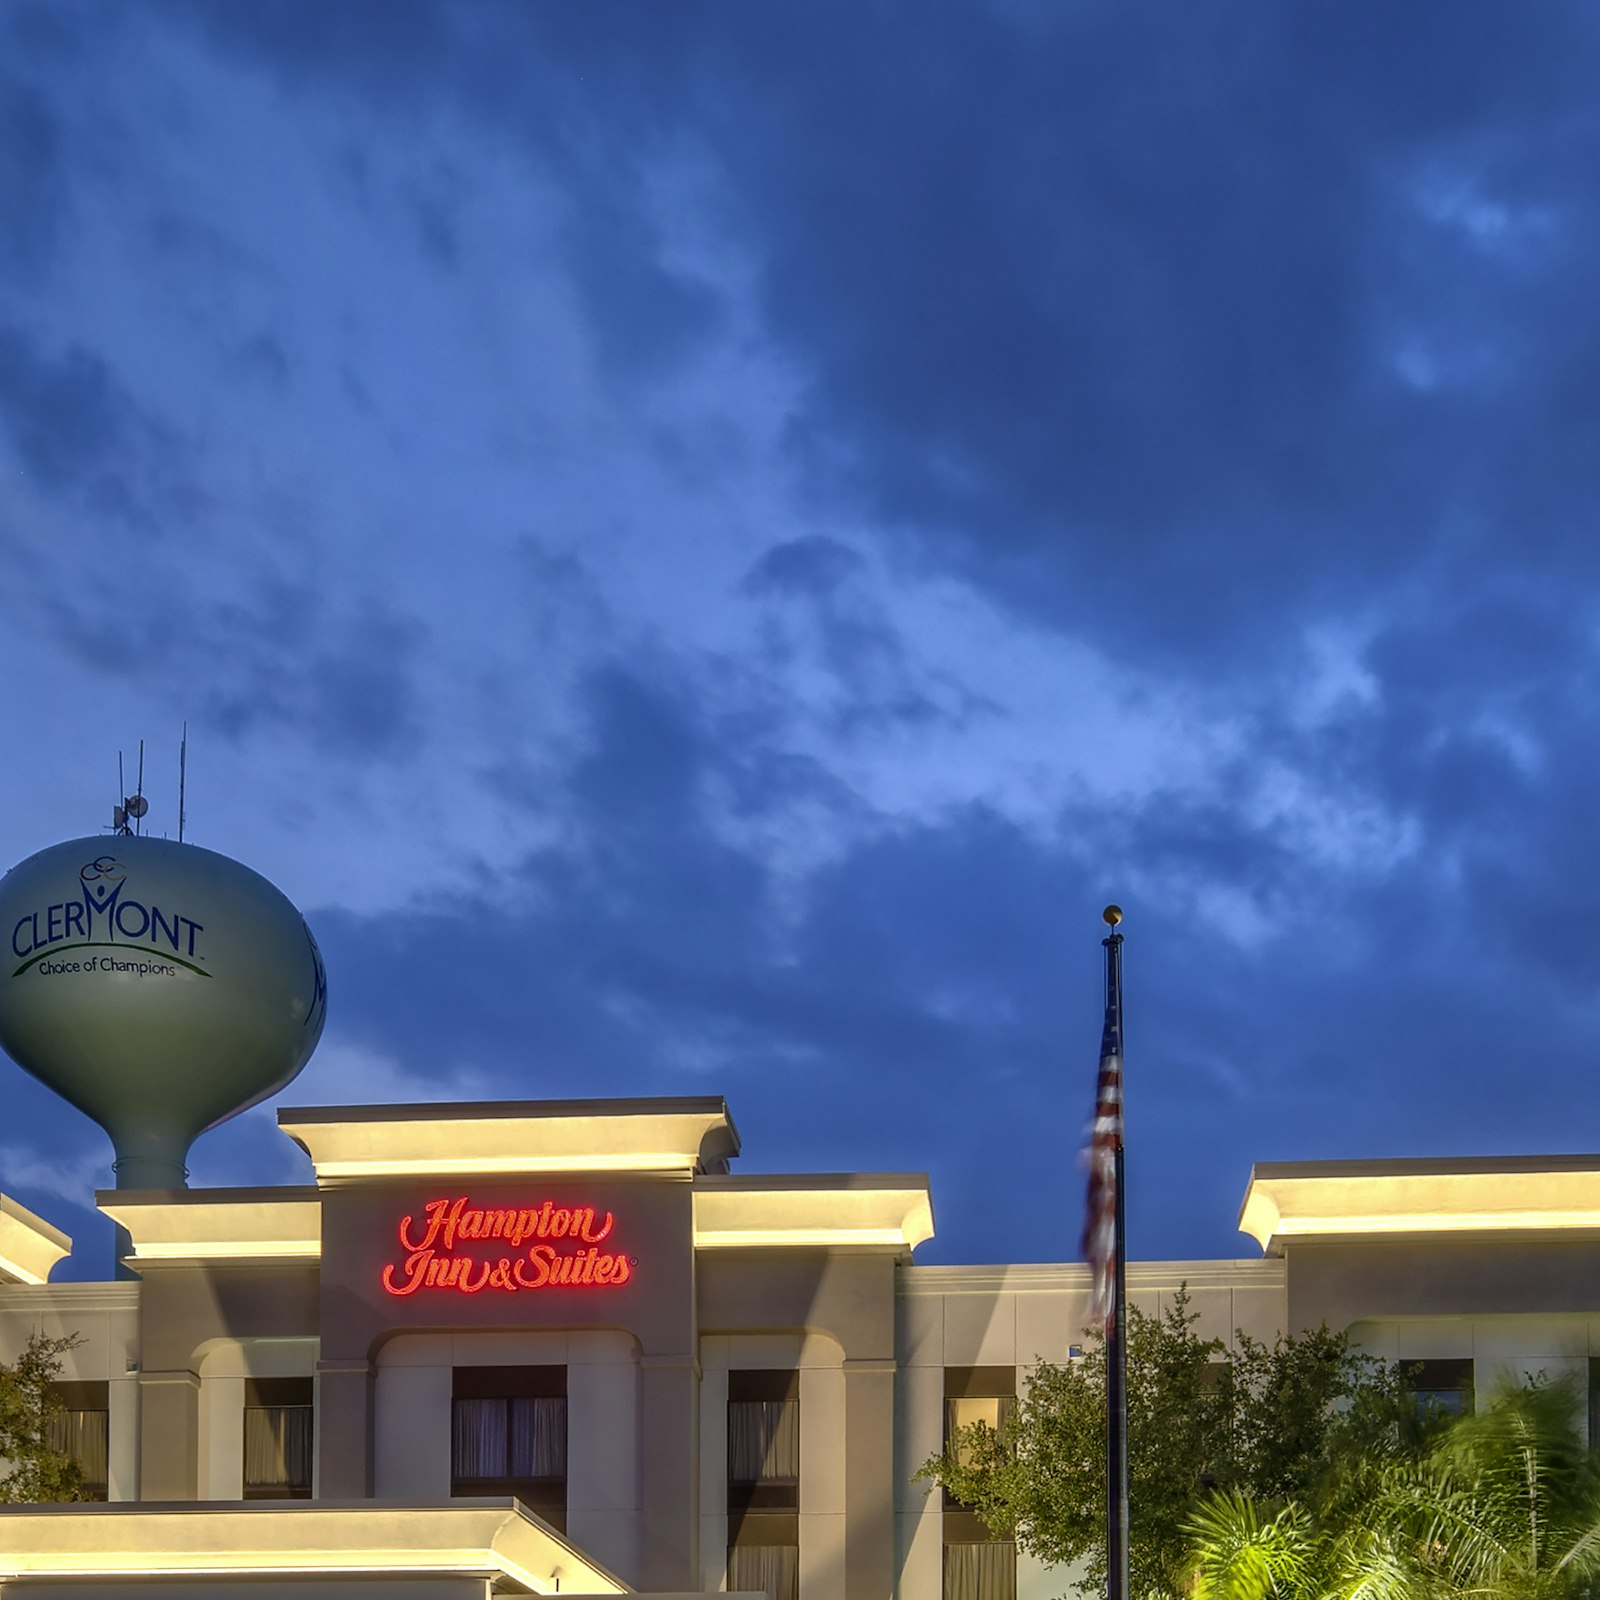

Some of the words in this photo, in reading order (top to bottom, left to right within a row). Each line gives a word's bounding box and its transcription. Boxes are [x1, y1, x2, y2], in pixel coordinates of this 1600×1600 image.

[11, 876, 204, 958] CLERMONT
[39, 960, 80, 976] Choice
[83, 957, 98, 972] of
[100, 957, 175, 978] Champions
[400, 1197, 613, 1251] Hampton
[383, 1250, 490, 1295] Inn
[489, 1258, 518, 1291] &
[514, 1245, 630, 1288] Suites
